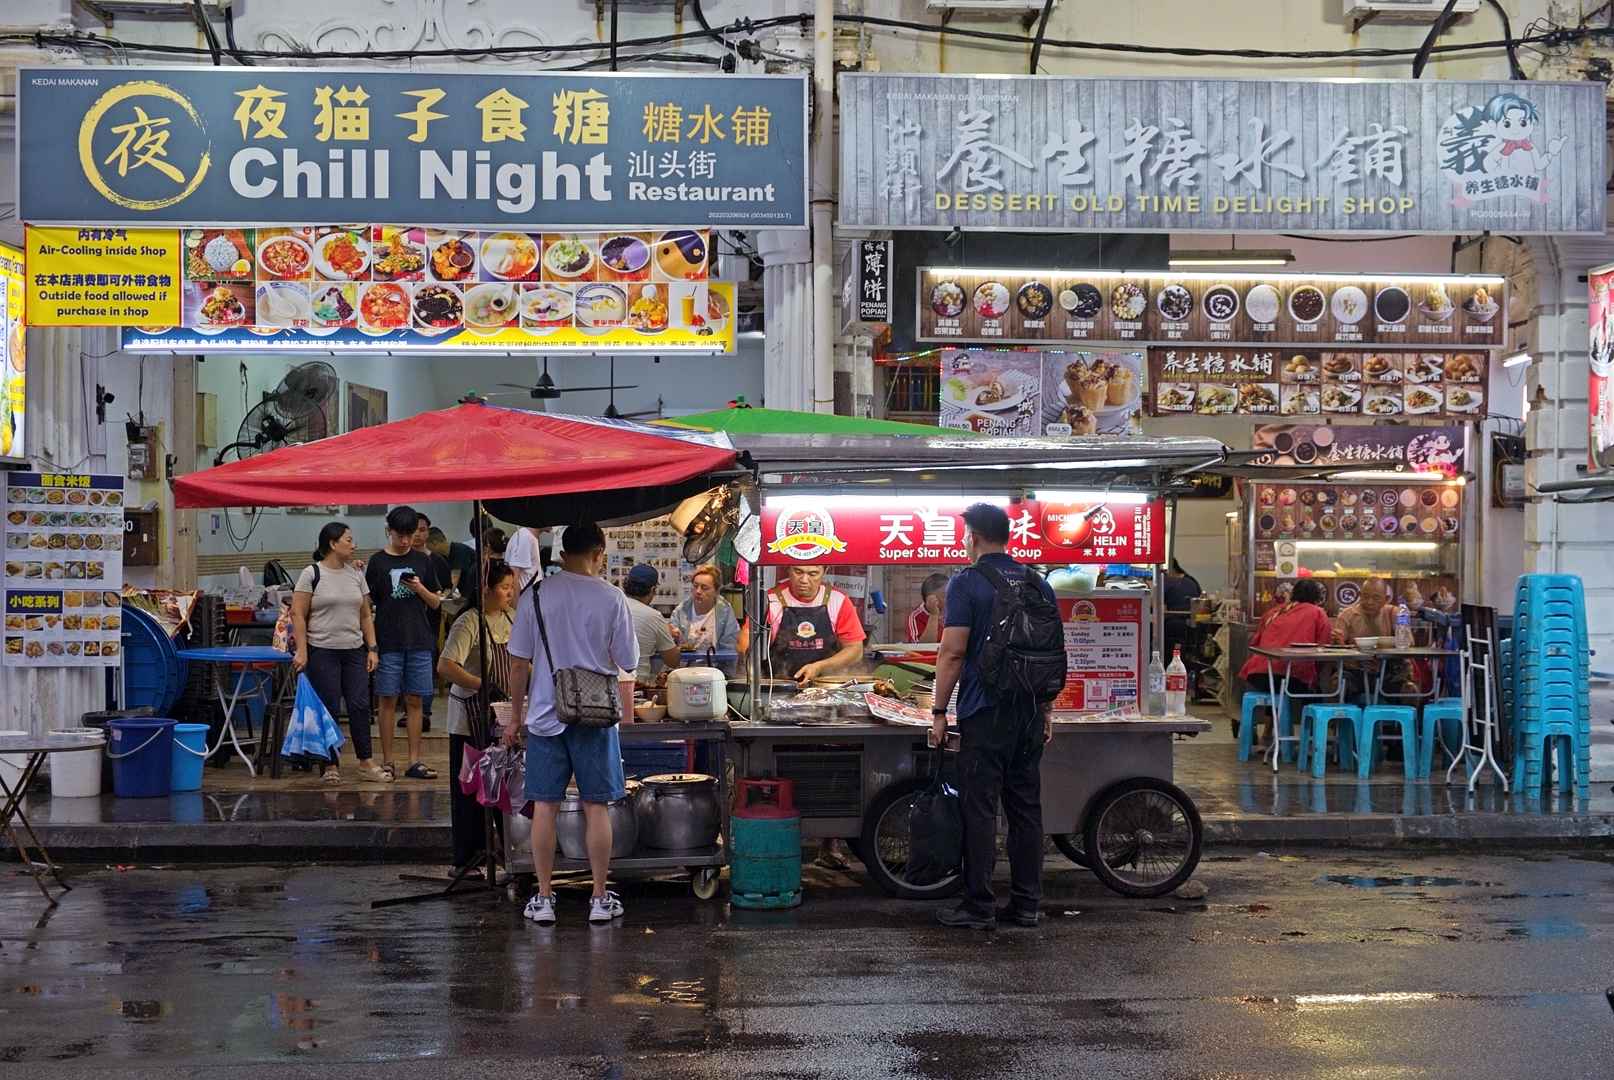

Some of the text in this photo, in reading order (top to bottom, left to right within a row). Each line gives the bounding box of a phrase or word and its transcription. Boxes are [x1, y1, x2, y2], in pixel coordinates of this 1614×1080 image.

[31, 78, 99, 86] KEDAI MAKANAN
[887, 92, 1019, 102] KEDAI MAKANAN DAN MINUMAN
[233, 83, 611, 145] 夜猫子食糖
[642, 101, 772, 146] 糖水铺
[104, 106, 186, 184] 夜
[627, 149, 717, 180] 汕头街
[880, 114, 922, 212] 汕頭街
[229, 146, 613, 214] Chill Night
[1464, 174, 1541, 196] 养生糖水铺
[628, 181, 775, 203] Restaurant
[935, 192, 1415, 215] DESSERT OLD TIME DELIGHT SHOP
[1470, 209, 1531, 219] PC0009444-W
[77, 228, 128, 242] 内有冷气
[39, 245, 168, 260] Air-Cooling inside Shop
[34, 273, 172, 288] 在本店消费即可外带食物
[38, 290, 82, 302] Outside
[84, 290, 109, 302] food
[112, 290, 156, 302] allowed
[158, 290, 168, 302] if
[860, 301, 888, 309] PENANG
[860, 307, 888, 316] POPIAH
[56, 306, 150, 319] purchase in shop
[977, 418, 1016, 428] PENANG
[979, 427, 1017, 437] POPIAH
[41, 473, 91, 488] 面食米饭
[788, 514, 823, 534] 天皇
[879, 507, 1042, 547] 天皇味
[879, 546, 1042, 560] Super Star Koa Soup
[1083, 547, 1118, 557] 米其林
[833, 580, 865, 592] Kimberly
[9, 595, 60, 609] 小吃系列
[1073, 637, 1096, 645] 11:00pm
[1074, 658, 1097, 666] 2:30pm
